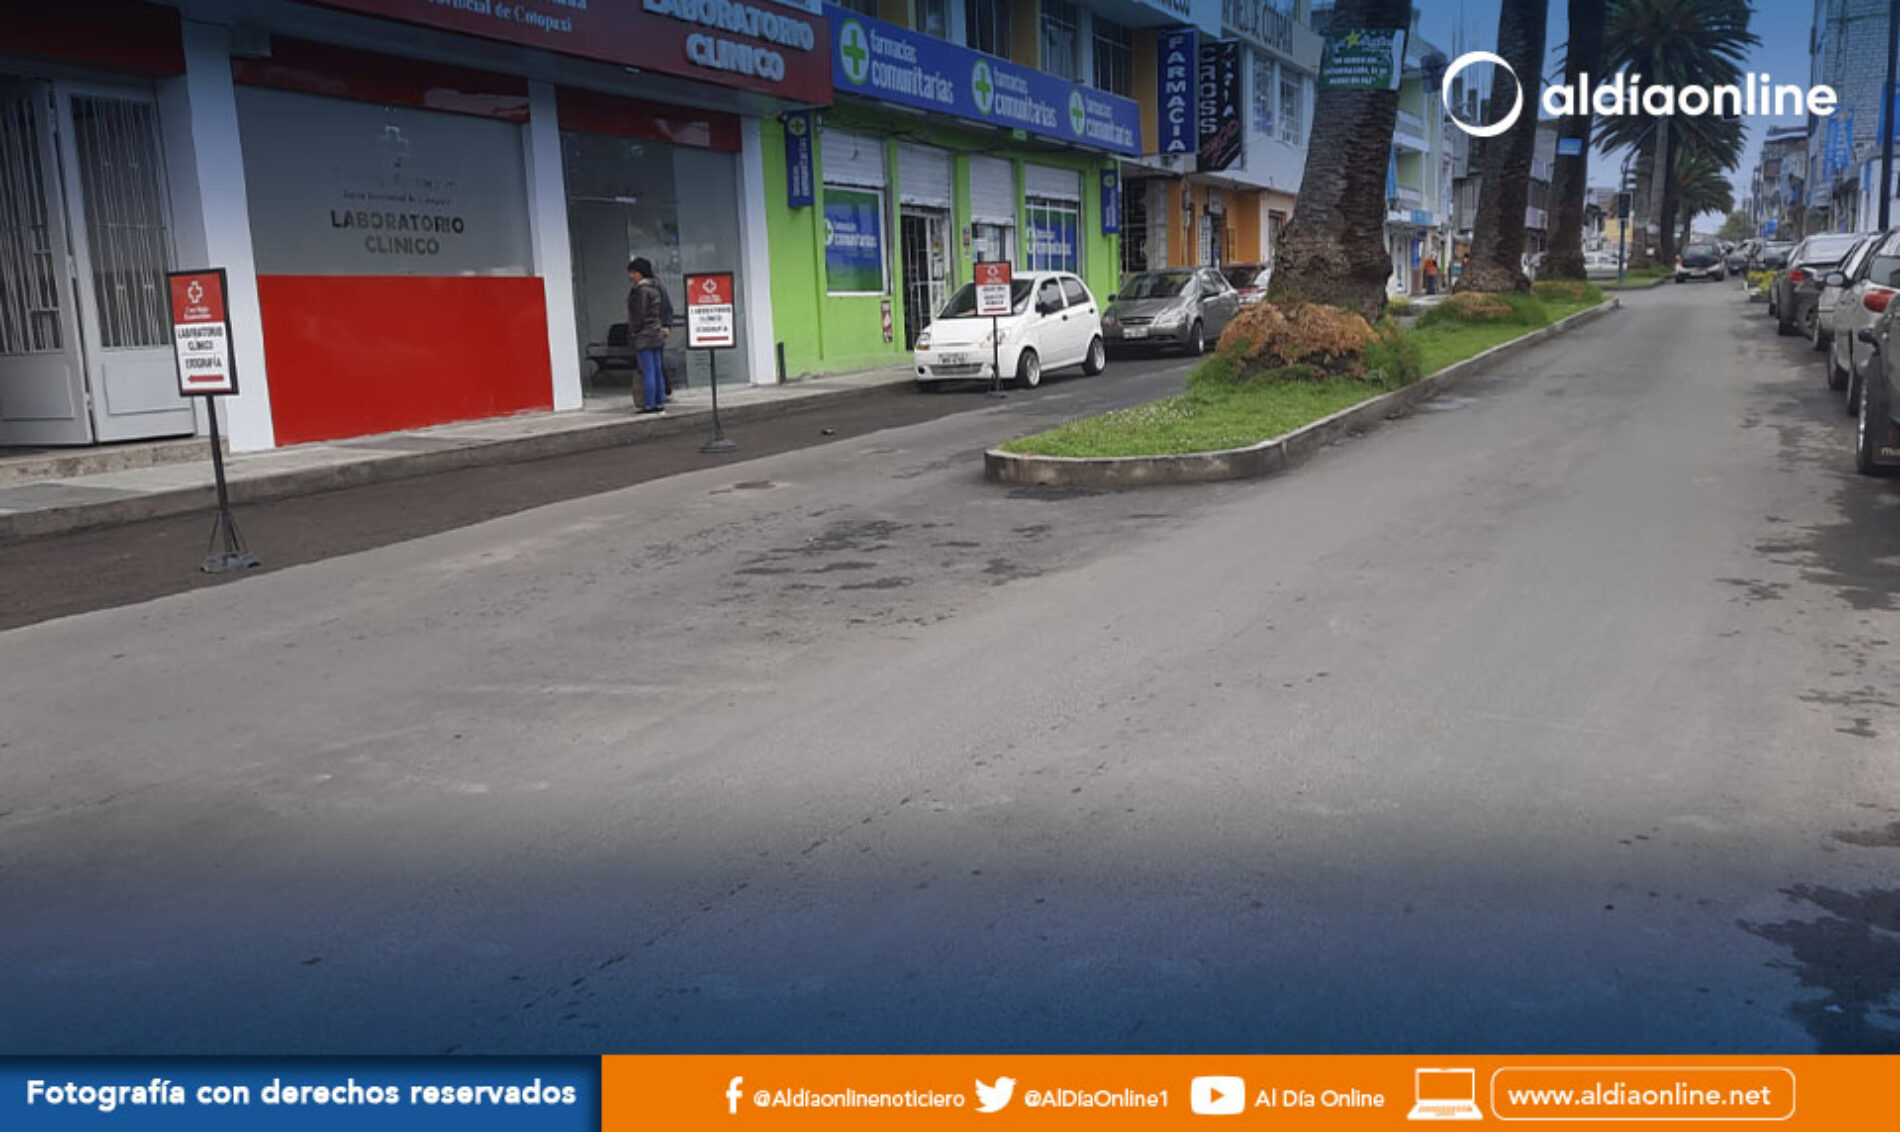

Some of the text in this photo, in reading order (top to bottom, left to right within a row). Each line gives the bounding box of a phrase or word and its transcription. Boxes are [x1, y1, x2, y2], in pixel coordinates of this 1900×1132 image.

[494, 5, 512, 20] de
[514, 5, 572, 33] Cotopaxi
[686, 33, 785, 82] CLINICO
[870, 28, 917, 64] farmacias
[871, 60, 955, 104] comunitarias
[1165, 35, 1187, 152] FARMACIA
[1200, 47, 1218, 134] CROSS
[330, 208, 465, 234] LABORATORIO
[364, 235, 440, 255] CLINICO
